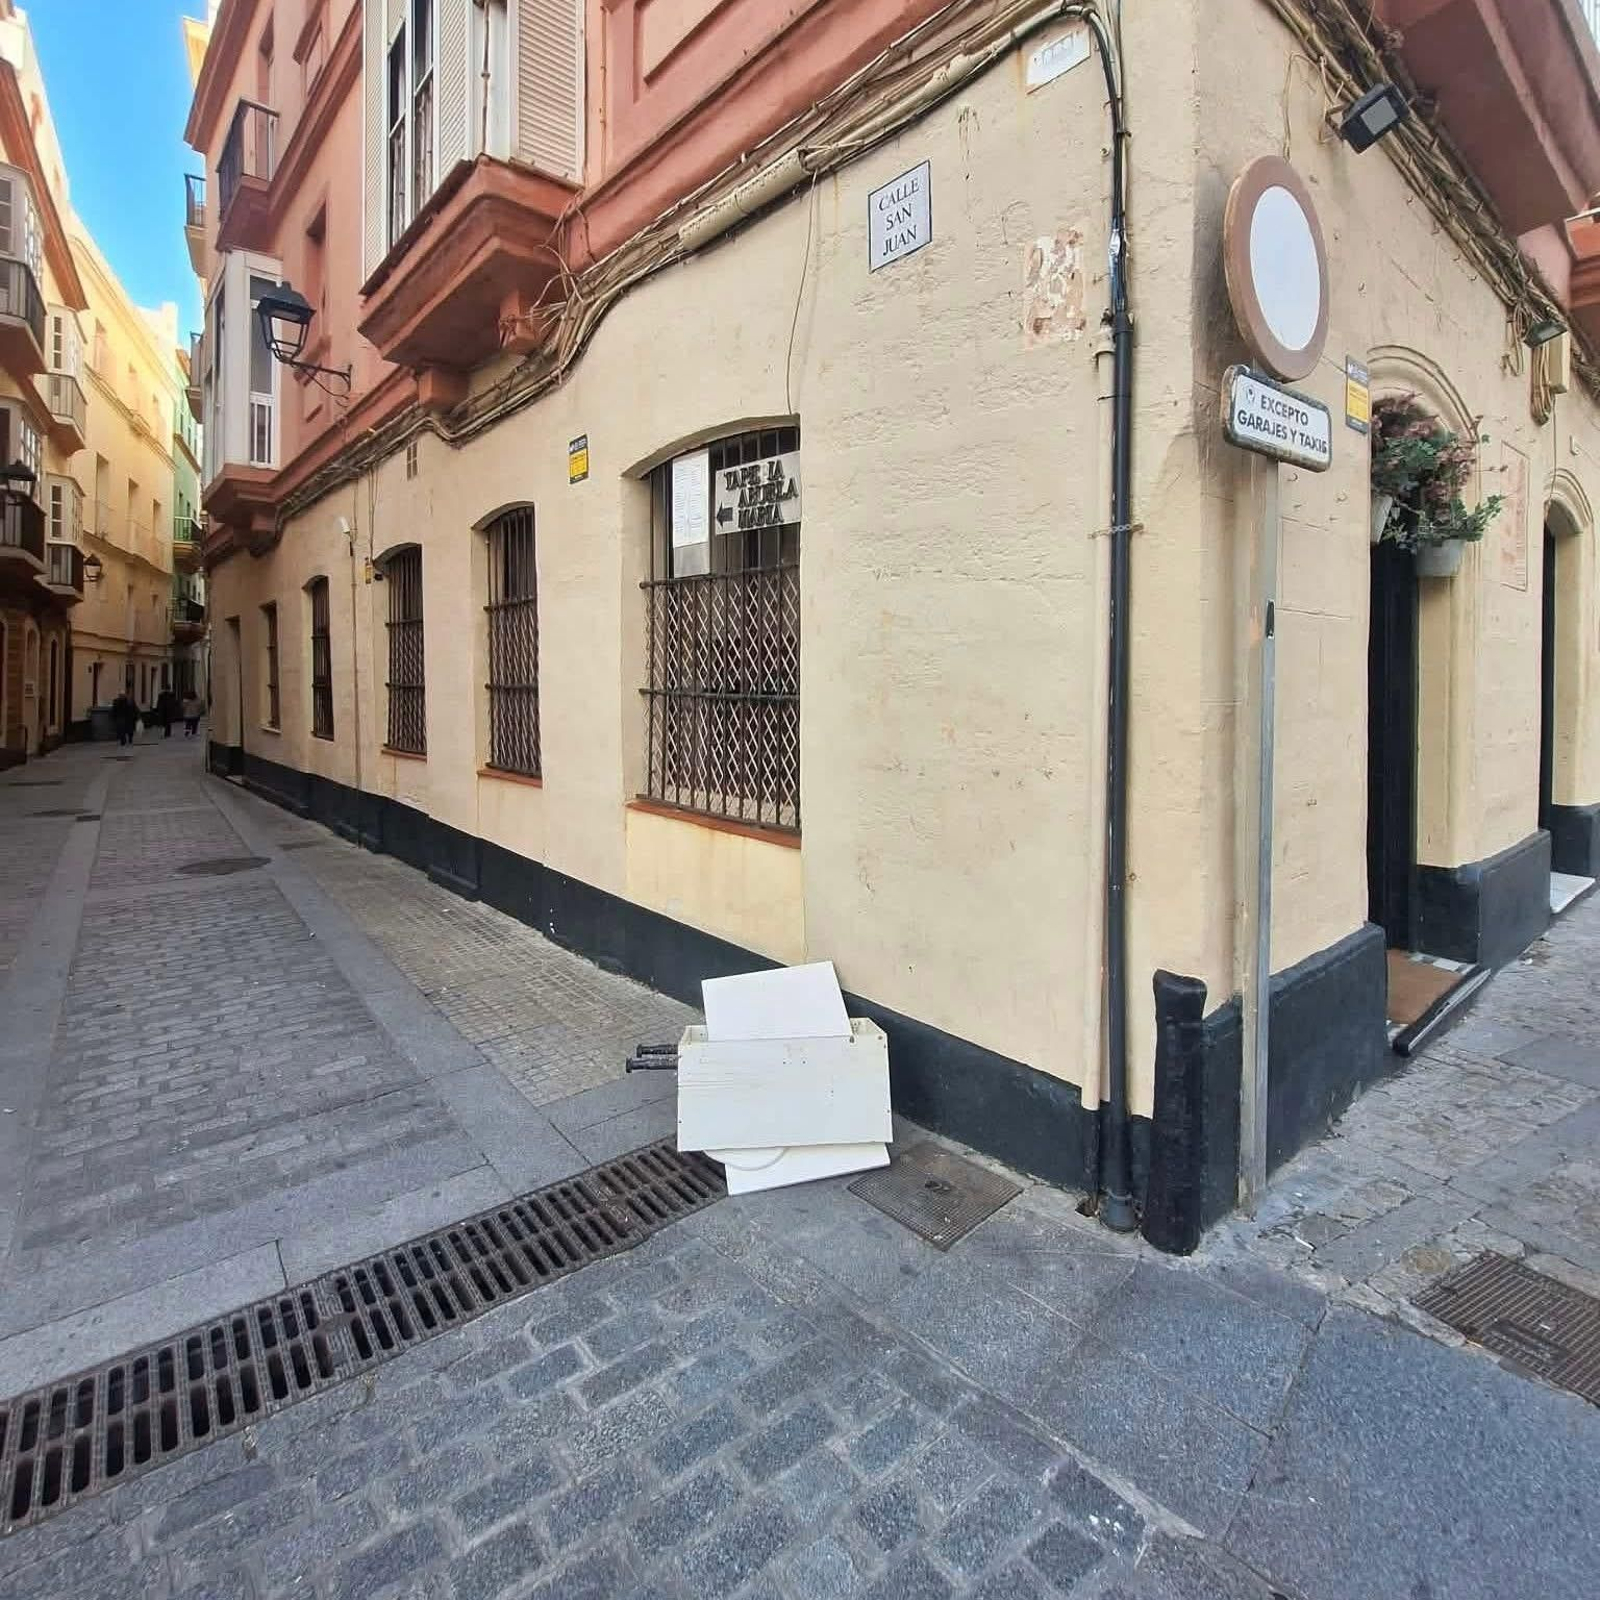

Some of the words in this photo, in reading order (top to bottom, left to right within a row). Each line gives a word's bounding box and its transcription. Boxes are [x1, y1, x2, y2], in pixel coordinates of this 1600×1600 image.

[879, 178, 919, 211] CALLE
[886, 203, 912, 231] SAN
[883, 224, 917, 256] JUAN
[1260, 395, 1309, 426] EXCEPTO
[1237, 409, 1287, 440] GARAJES
[1290, 429, 1298, 444] Y
[1299, 432, 1327, 454] TAXIS
